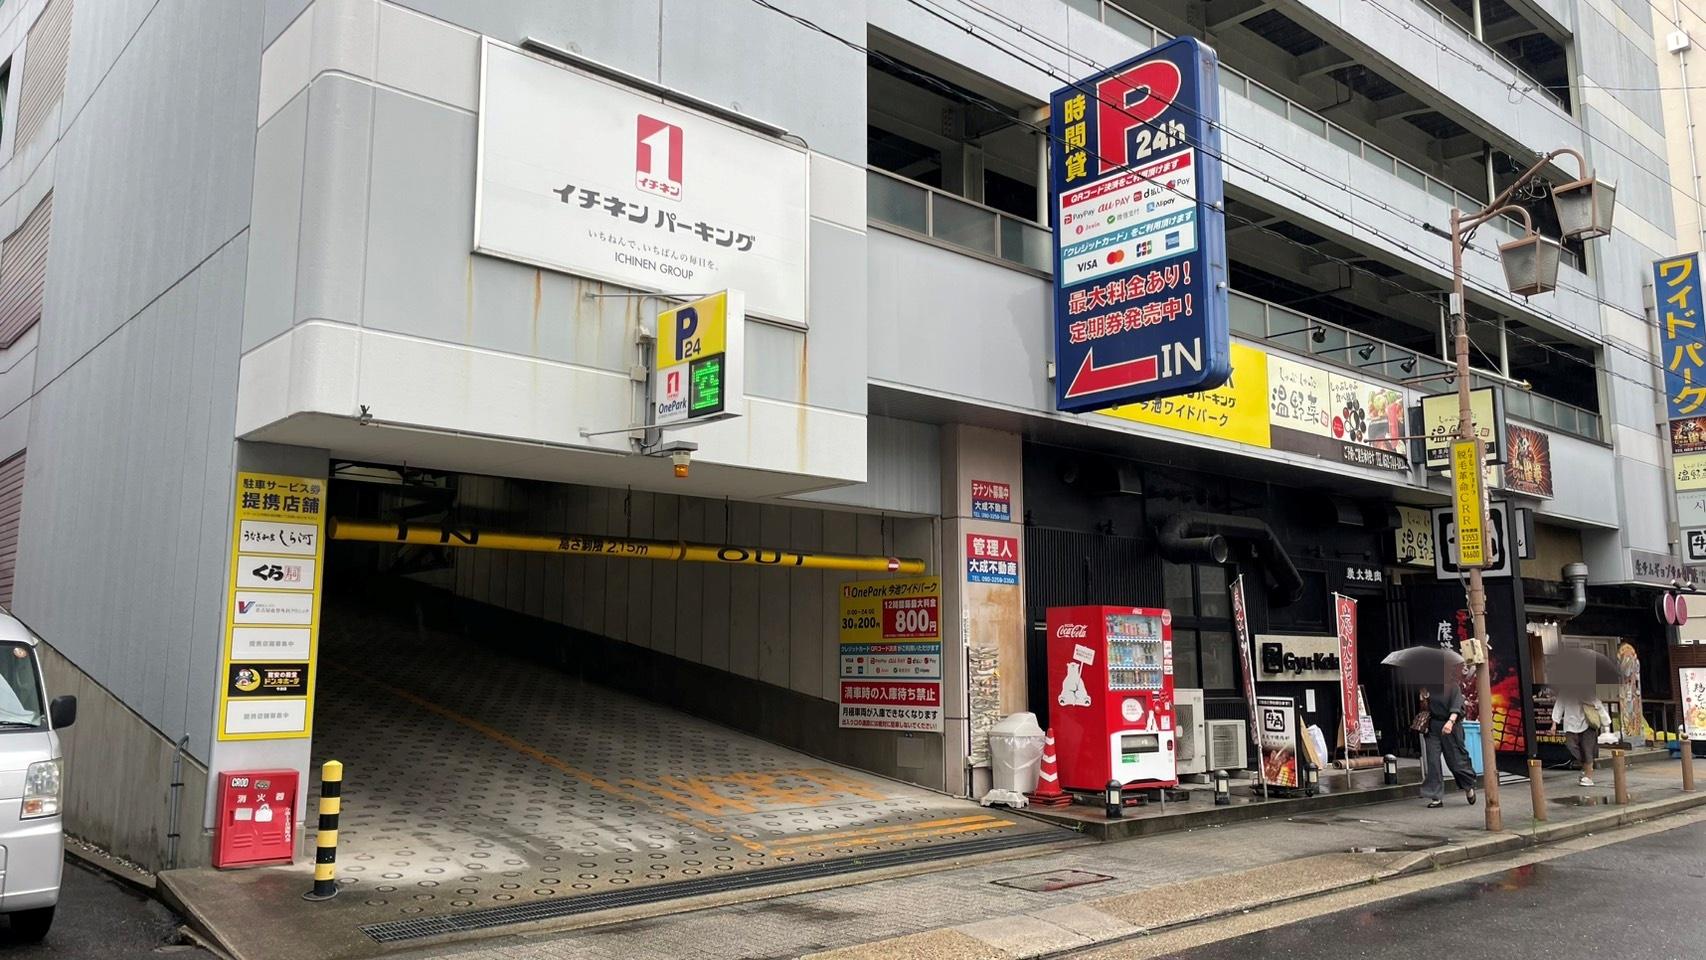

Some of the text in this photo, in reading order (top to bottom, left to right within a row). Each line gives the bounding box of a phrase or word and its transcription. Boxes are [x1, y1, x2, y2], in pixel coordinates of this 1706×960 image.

[1096, 59, 1182, 175] P
[1064, 93, 1087, 183] 時間貸
[1136, 119, 1186, 160] 24h
[638, 177, 681, 197] イチネン
[553, 184, 756, 252] イチネン パーキング
[1073, 209, 1095, 220] PayPay
[614, 251, 694, 280] ICHINEN GROUP
[1077, 259, 1098, 273] VISA
[675, 306, 701, 361] P 24
[1659, 258, 1706, 414] ワイドパーク
[1161, 337, 1202, 378] IN
[658, 398, 687, 414] OnePark
[243, 478, 321, 495] 駐車サービス券
[973, 482, 1009, 500] テナント募集中
[242, 492, 320, 514] 提携店舗
[974, 500, 1008, 514] 大成不動産
[606, 540, 648, 556] 2.15m
[717, 546, 813, 567] OUT
[973, 537, 1013, 559] 管理人
[252, 564, 284, 581] くら
[969, 558, 1017, 576] 大成不動産
[851, 585, 887, 598] OnePark
[844, 686, 937, 702] 満車時の入庫待ち禁止
